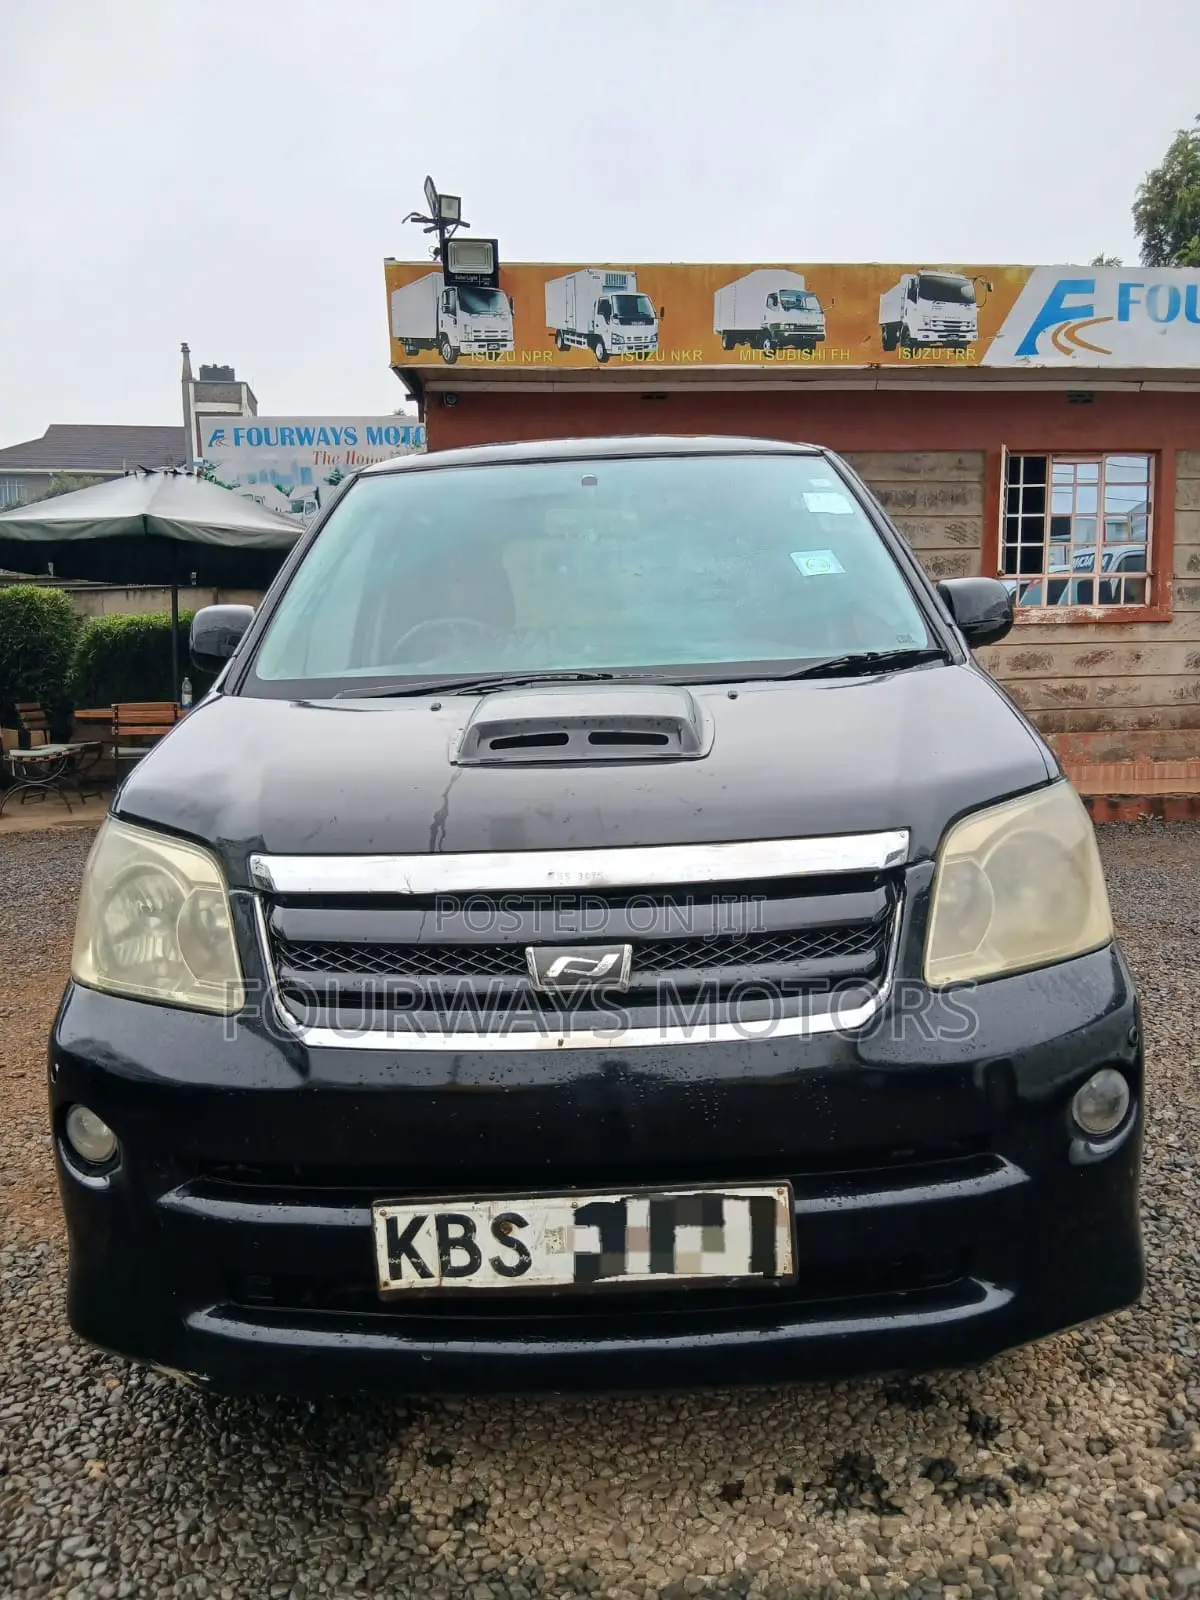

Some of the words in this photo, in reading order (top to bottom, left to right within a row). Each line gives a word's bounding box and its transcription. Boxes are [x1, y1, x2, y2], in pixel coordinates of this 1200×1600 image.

[471, 350, 516, 362] ISUZU
[521, 350, 553, 362] NPR
[620, 349, 665, 362] ISUZU
[671, 350, 703, 361] NKR
[739, 349, 827, 361] MITSUBISHI
[831, 349, 850, 360] FH
[898, 348, 942, 360] ISUZU
[947, 348, 976, 360] FRR
[233, 427, 358, 447] FOURWAYS
[313, 450, 340, 465] The
[387, 1211, 533, 1281] KBS
